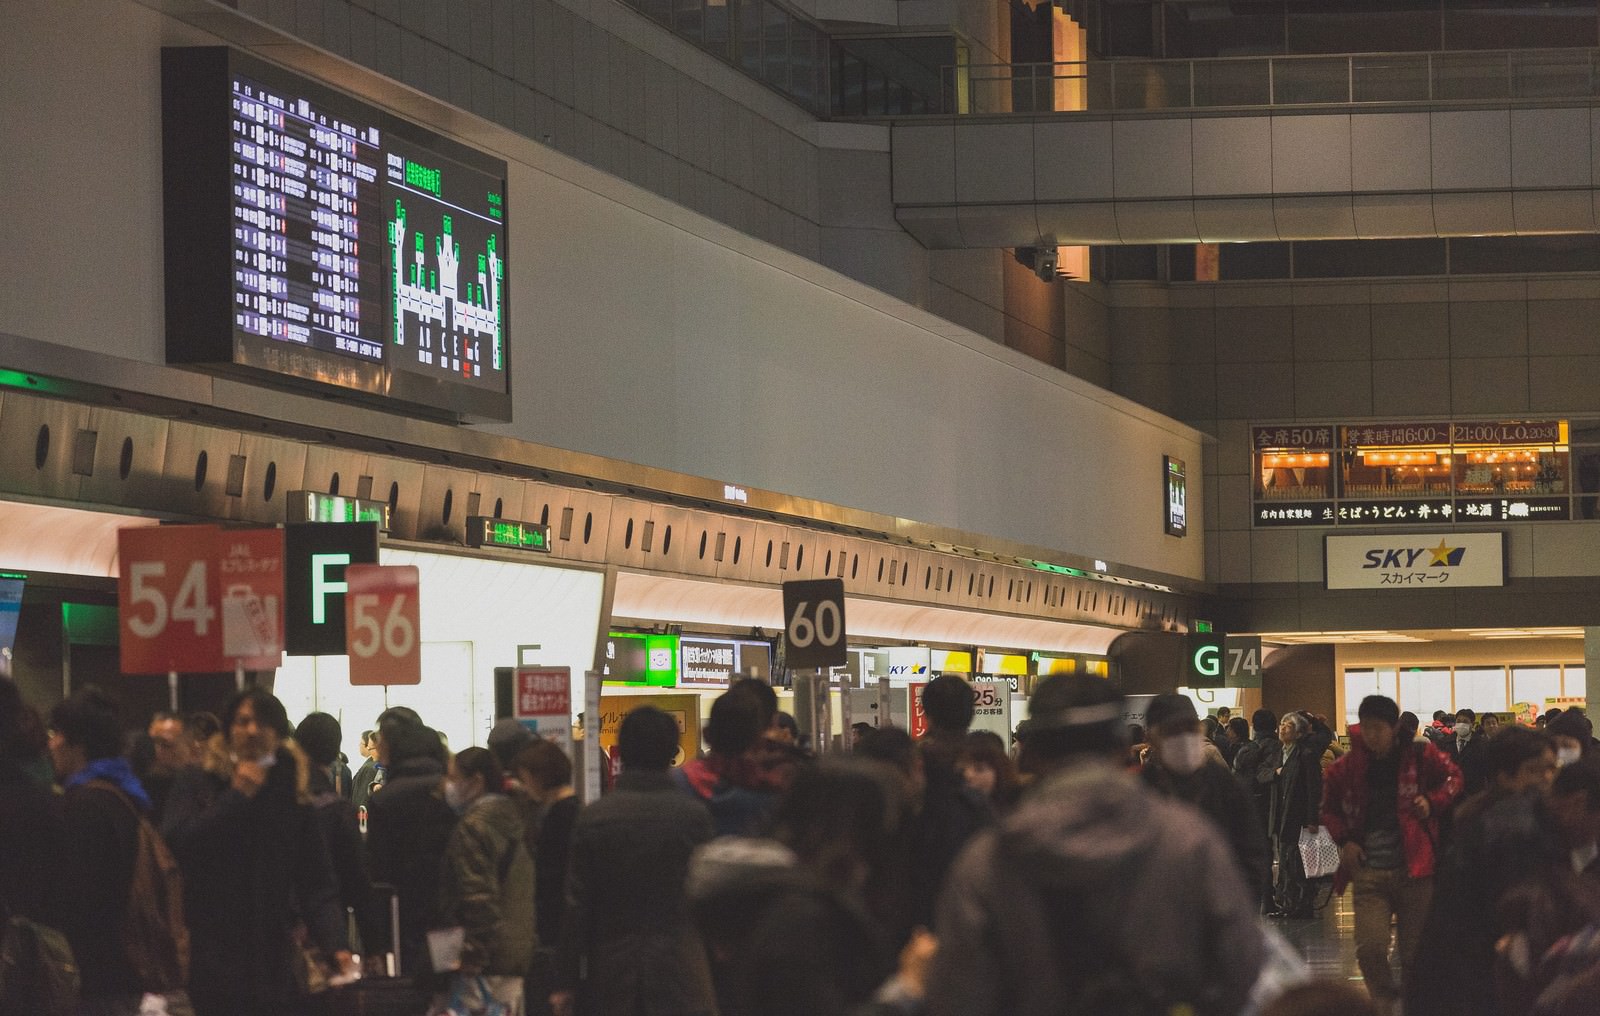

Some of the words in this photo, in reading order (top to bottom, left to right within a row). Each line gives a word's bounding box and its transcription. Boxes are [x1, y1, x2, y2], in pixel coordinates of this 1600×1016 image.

[1257, 428, 1329, 445] 全席50席
[1362, 548, 1425, 568] SKY
[312, 553, 350, 625] F
[1380, 572, 1449, 584] スカイマーク
[128, 561, 214, 638] 54
[353, 594, 414, 658] 56
[788, 600, 841, 648] 60
[1194, 645, 1220, 676] G
[1228, 649, 1259, 676] 74
